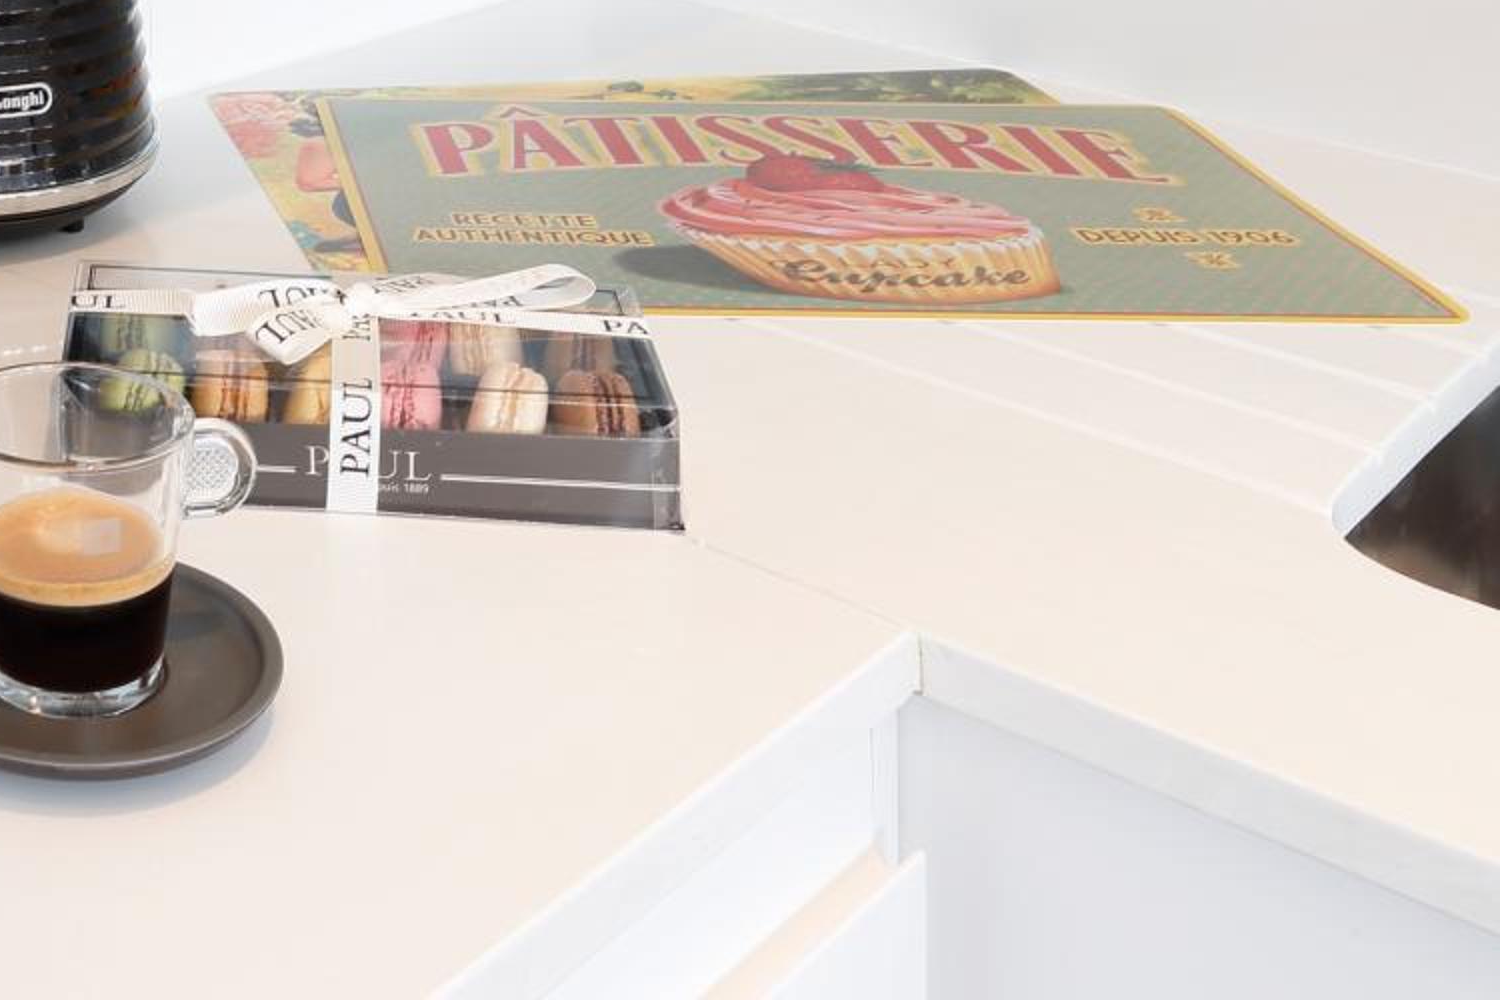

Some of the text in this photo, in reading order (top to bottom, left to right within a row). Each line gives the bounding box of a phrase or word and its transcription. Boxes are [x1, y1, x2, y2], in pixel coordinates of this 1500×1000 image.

[418, 105, 1172, 184] PÂTISSERIE
[415, 228, 655, 246] AUTHENTIQUE
[450, 212, 597, 228] RECETTE
[1075, 228, 1297, 246] DEPUIS 1906
[768, 257, 1032, 294] Cupcake
[339, 379, 373, 479] PAUL
[303, 444, 433, 482] PUL
